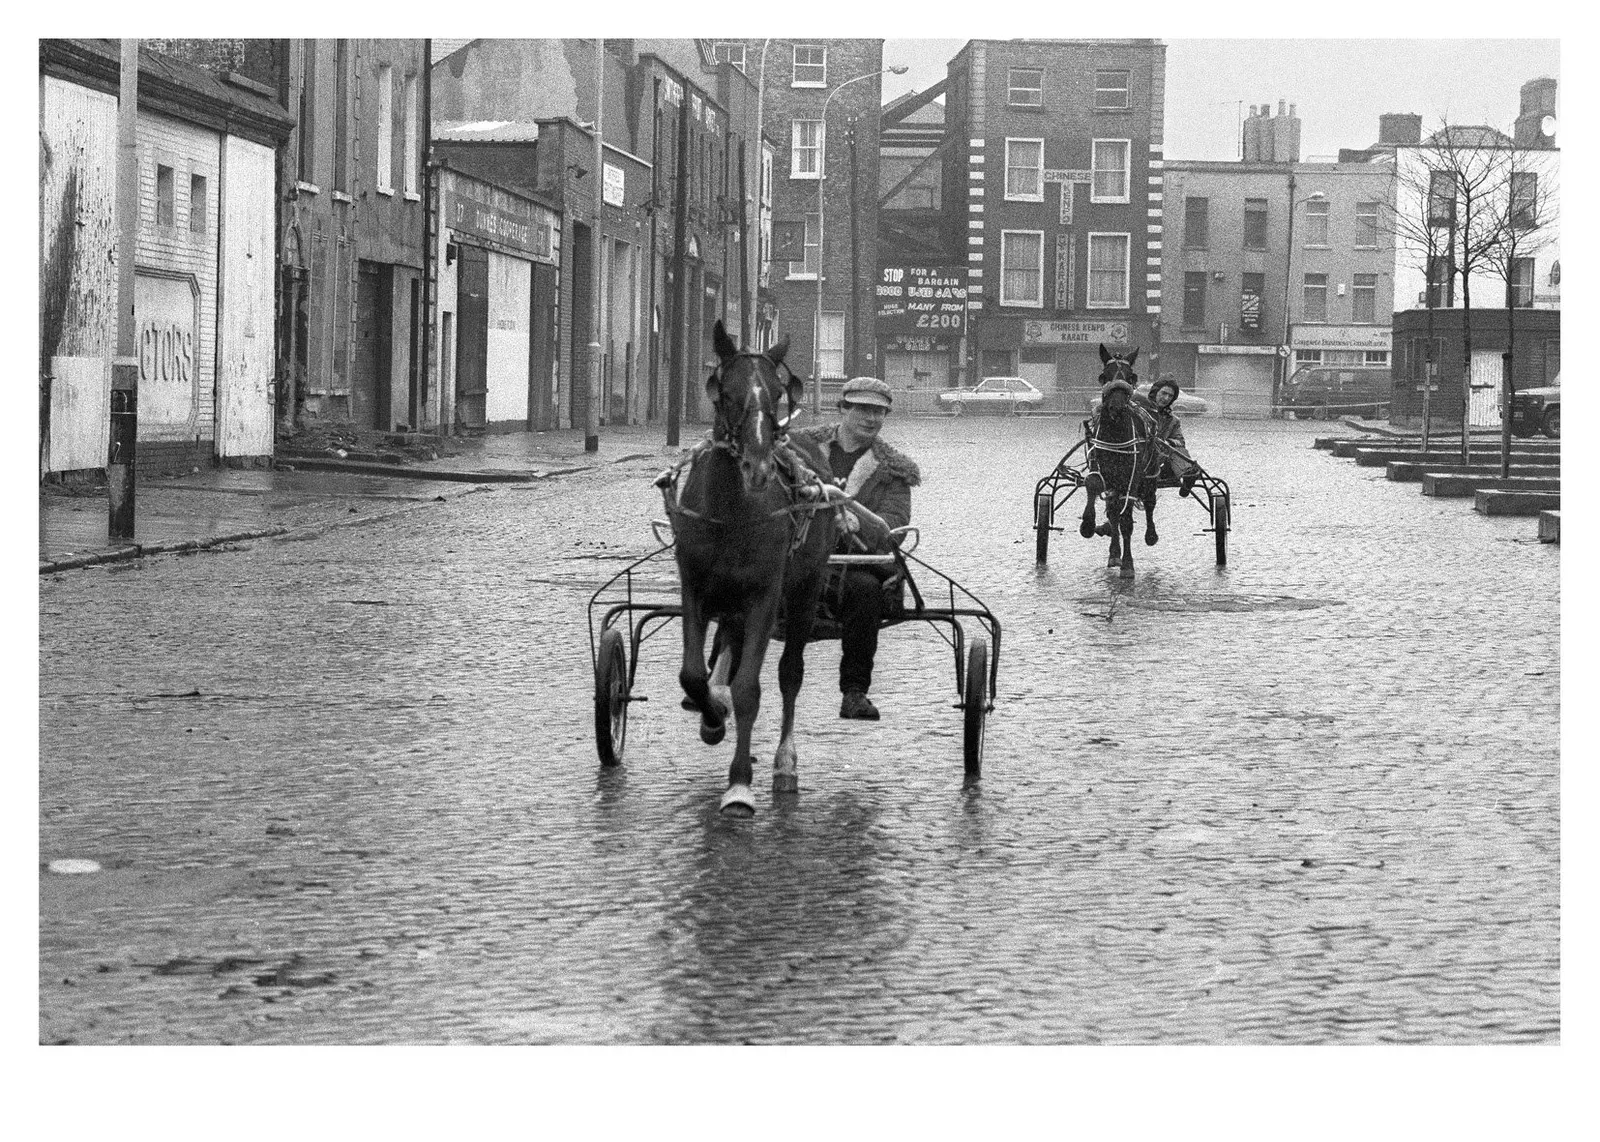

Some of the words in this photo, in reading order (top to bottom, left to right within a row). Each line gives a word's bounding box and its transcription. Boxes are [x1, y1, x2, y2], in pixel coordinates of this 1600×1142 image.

[1044, 171, 1092, 181] CHINESE
[883, 268, 904, 282] STOP
[910, 268, 927, 276] FOR
[917, 277, 959, 286] BARGAIN
[1058, 252, 1068, 309] KARATE
[907, 286, 934, 298] USED
[934, 287, 967, 299] CARS
[907, 303, 936, 312] MANY
[940, 303, 964, 312] FROM
[916, 314, 961, 328] £200
[1050, 323, 1080, 332] CHINESE
[1082, 323, 1106, 332] KENPO
[1061, 333, 1089, 341] KARATE
